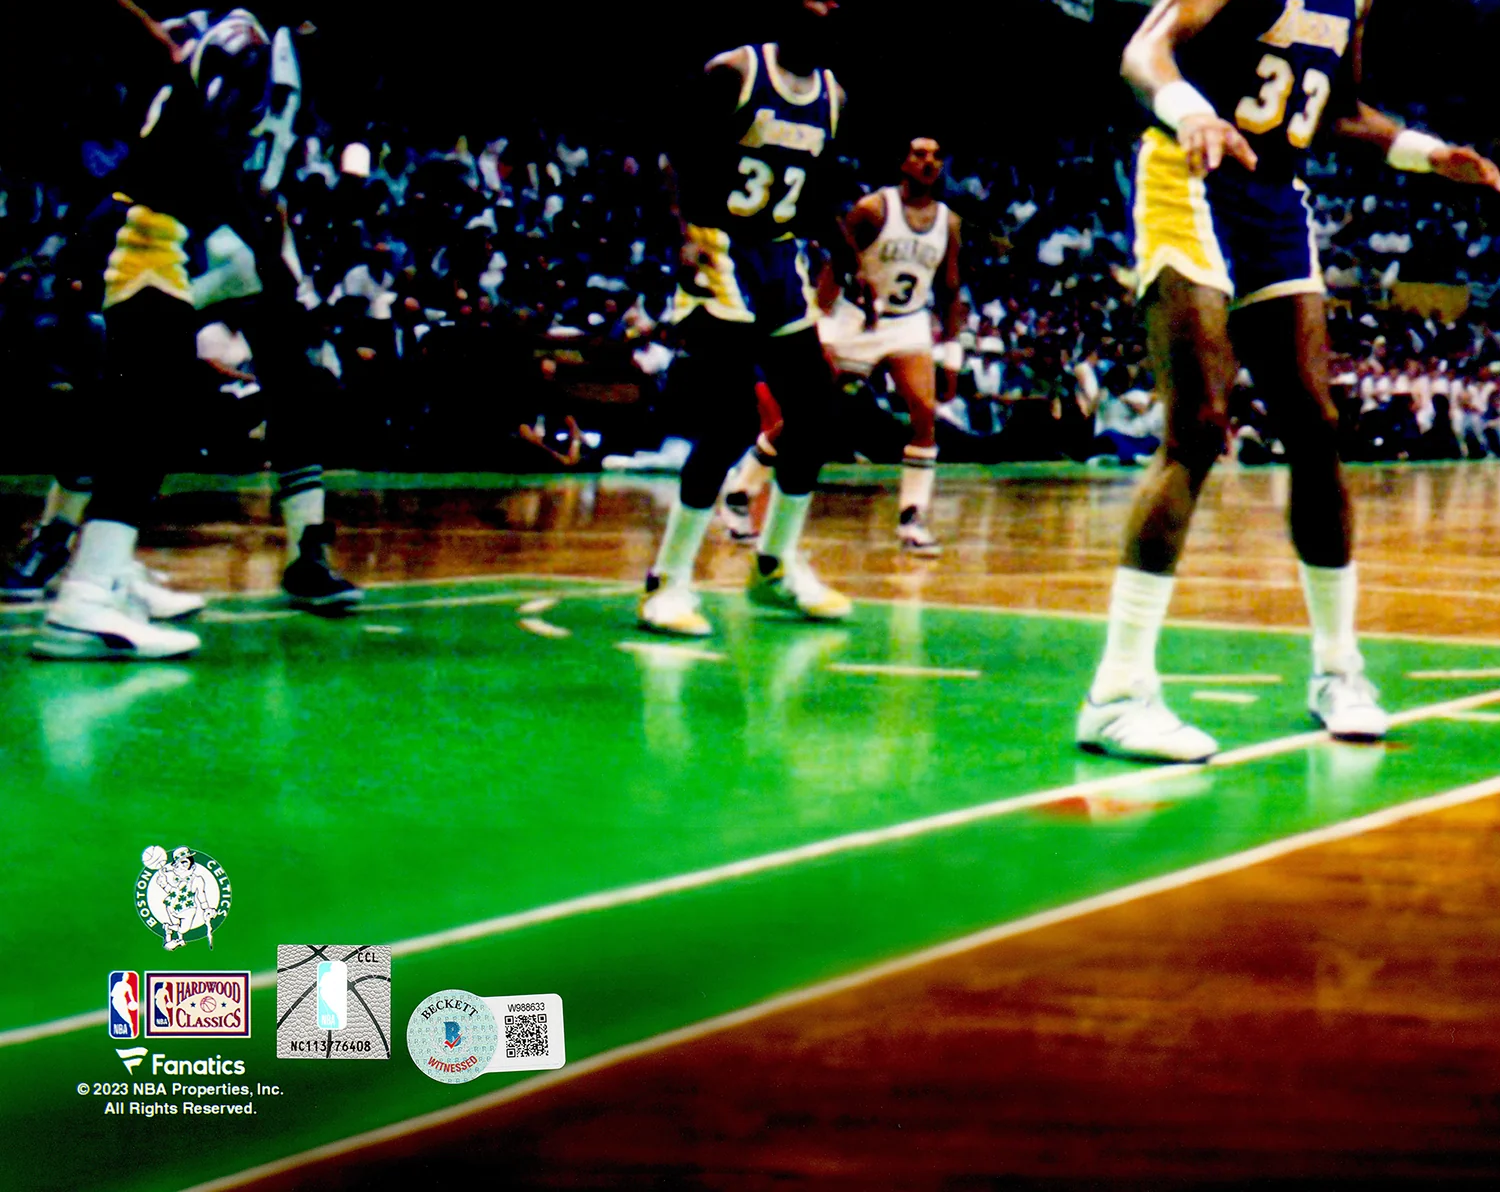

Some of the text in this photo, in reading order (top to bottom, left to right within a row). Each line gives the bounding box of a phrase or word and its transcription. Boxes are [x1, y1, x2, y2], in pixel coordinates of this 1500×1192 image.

[887, 273, 918, 307] 3
[358, 952, 378, 963] CCL
[421, 998, 478, 1020] BECKETT
[322, 1014, 335, 1025] NBA
[291, 1041, 371, 1051] NC113776408
[428, 1055, 478, 1073] WITNESSED
